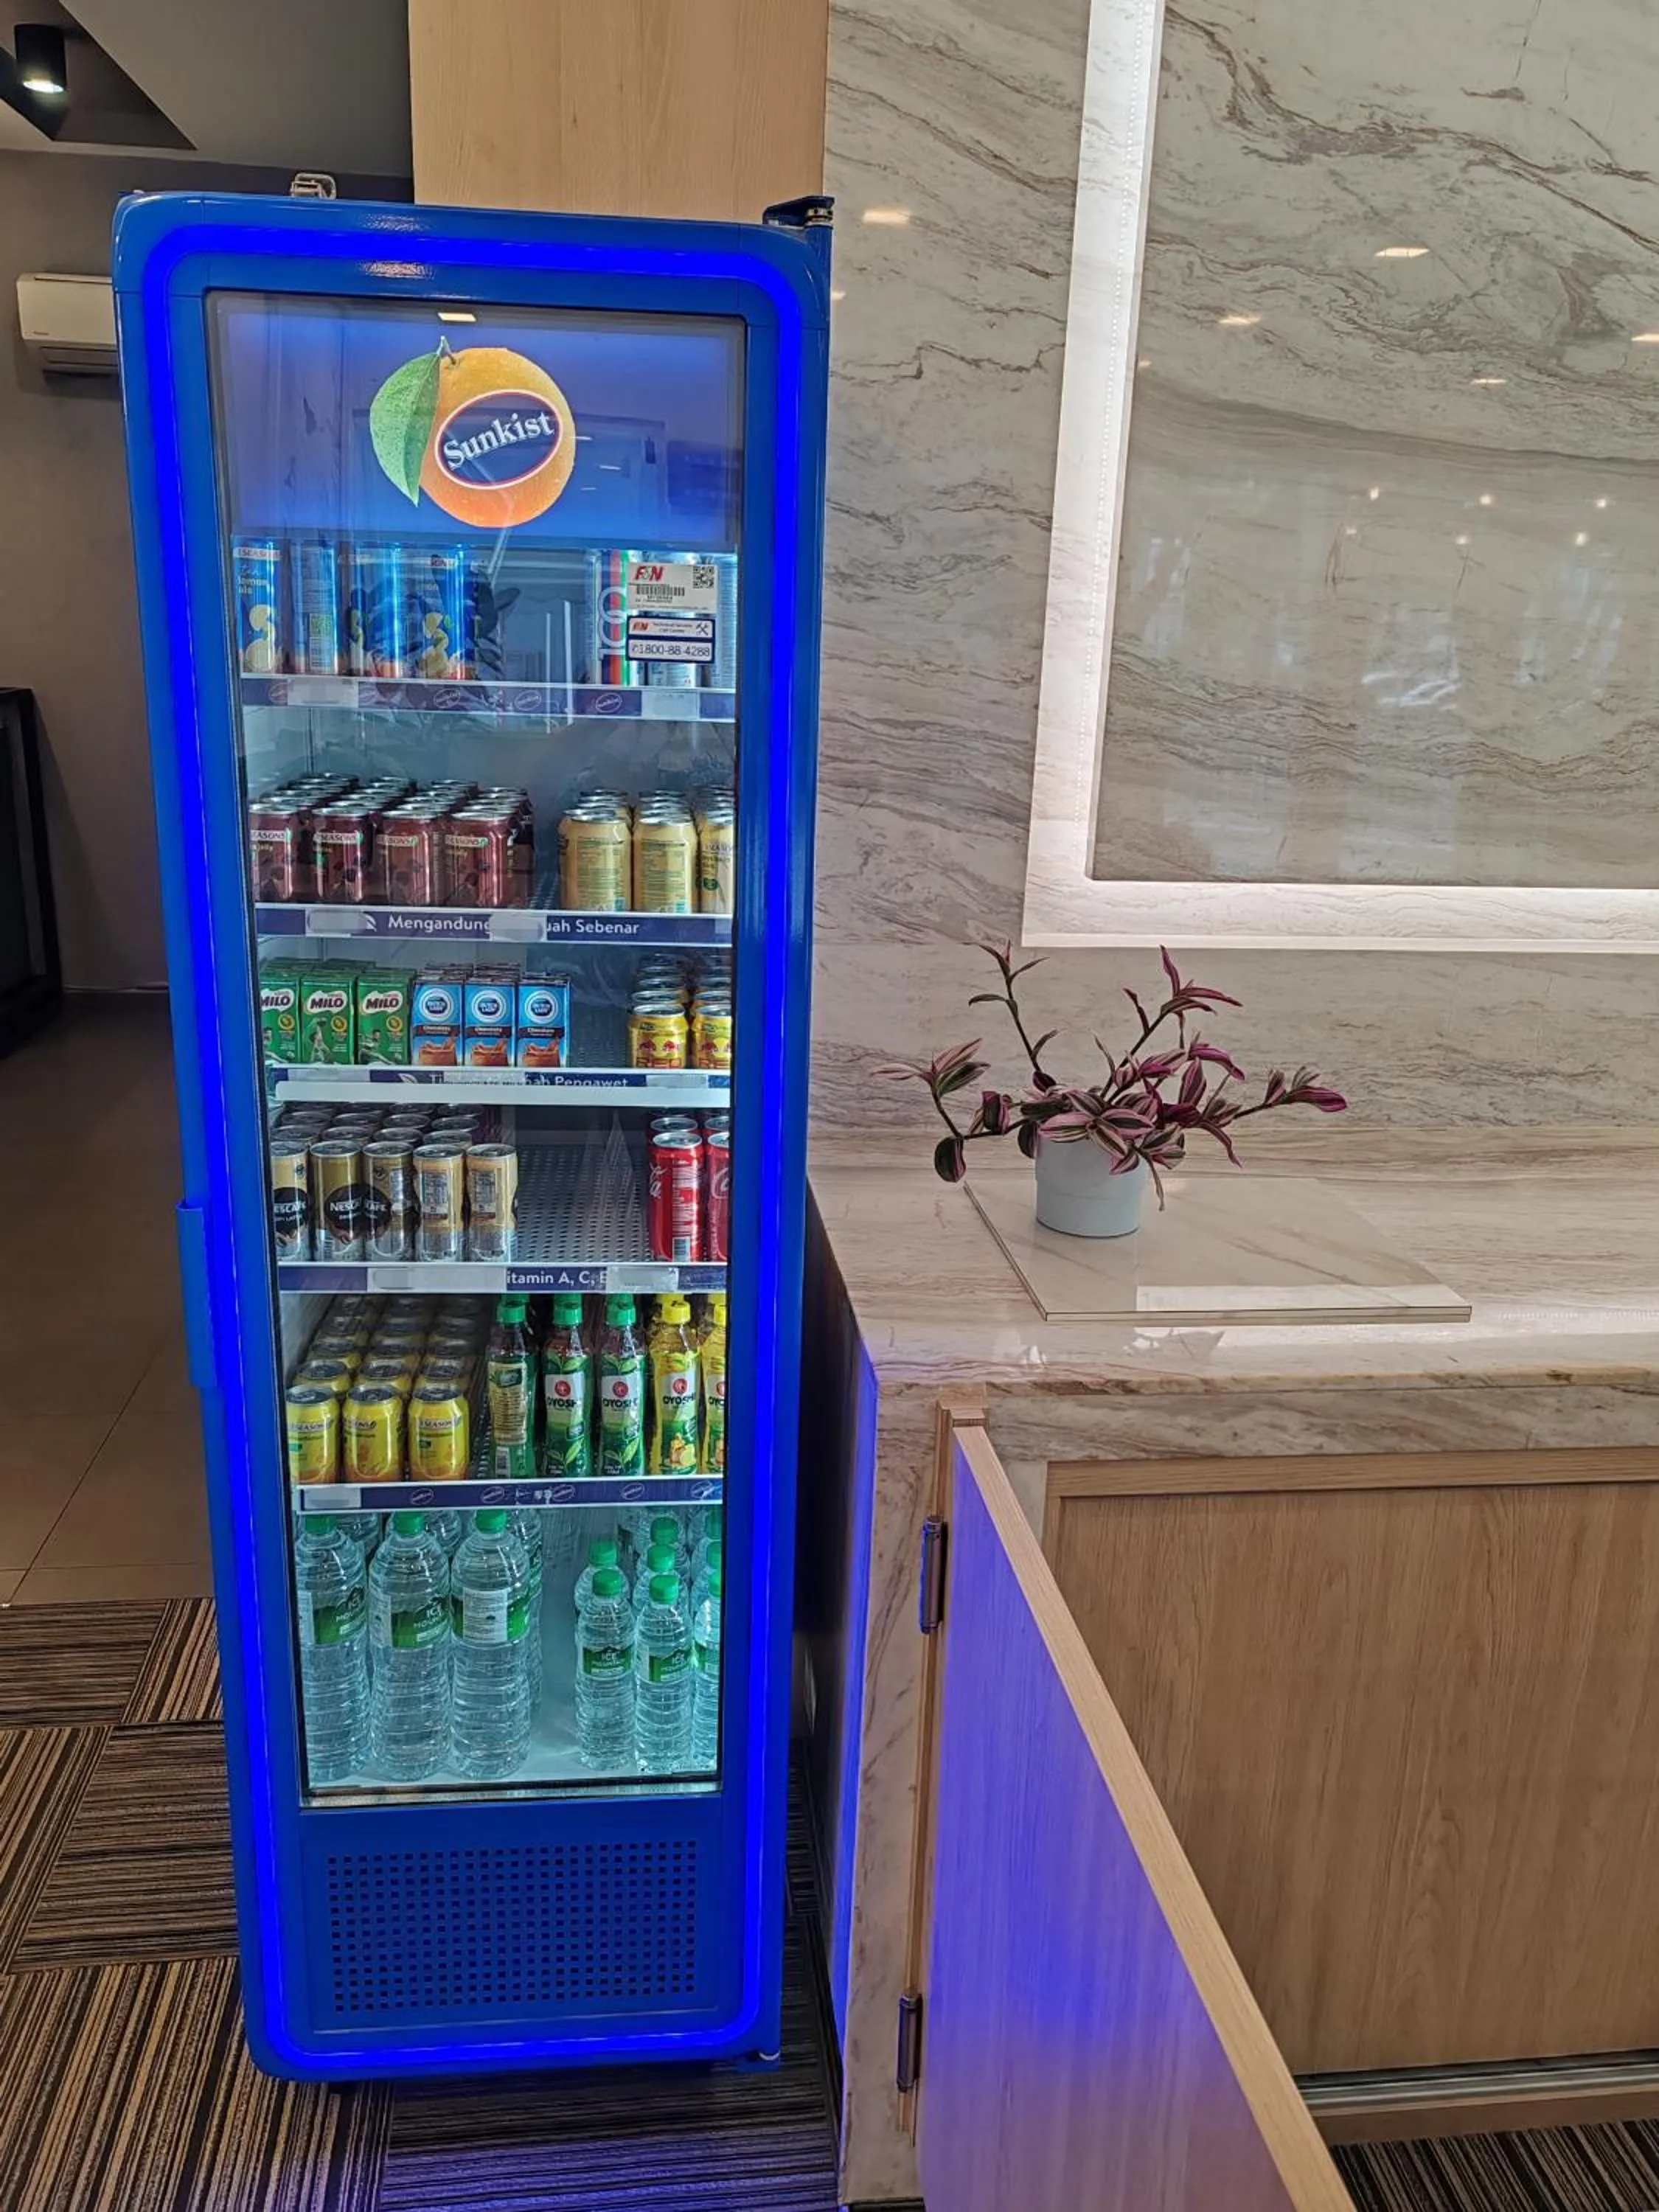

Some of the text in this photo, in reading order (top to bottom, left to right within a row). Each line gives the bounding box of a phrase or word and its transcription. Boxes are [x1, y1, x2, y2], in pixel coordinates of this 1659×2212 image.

[444, 412, 554, 470] Sunkist
[635, 566, 664, 581] F&N
[575, 919, 640, 934] Sebenar
[260, 995, 291, 1007] MILO
[310, 997, 344, 1010] MILO
[366, 997, 400, 1010] MILO
[558, 1271, 574, 1287] A,
[579, 1270, 595, 1287] C,
